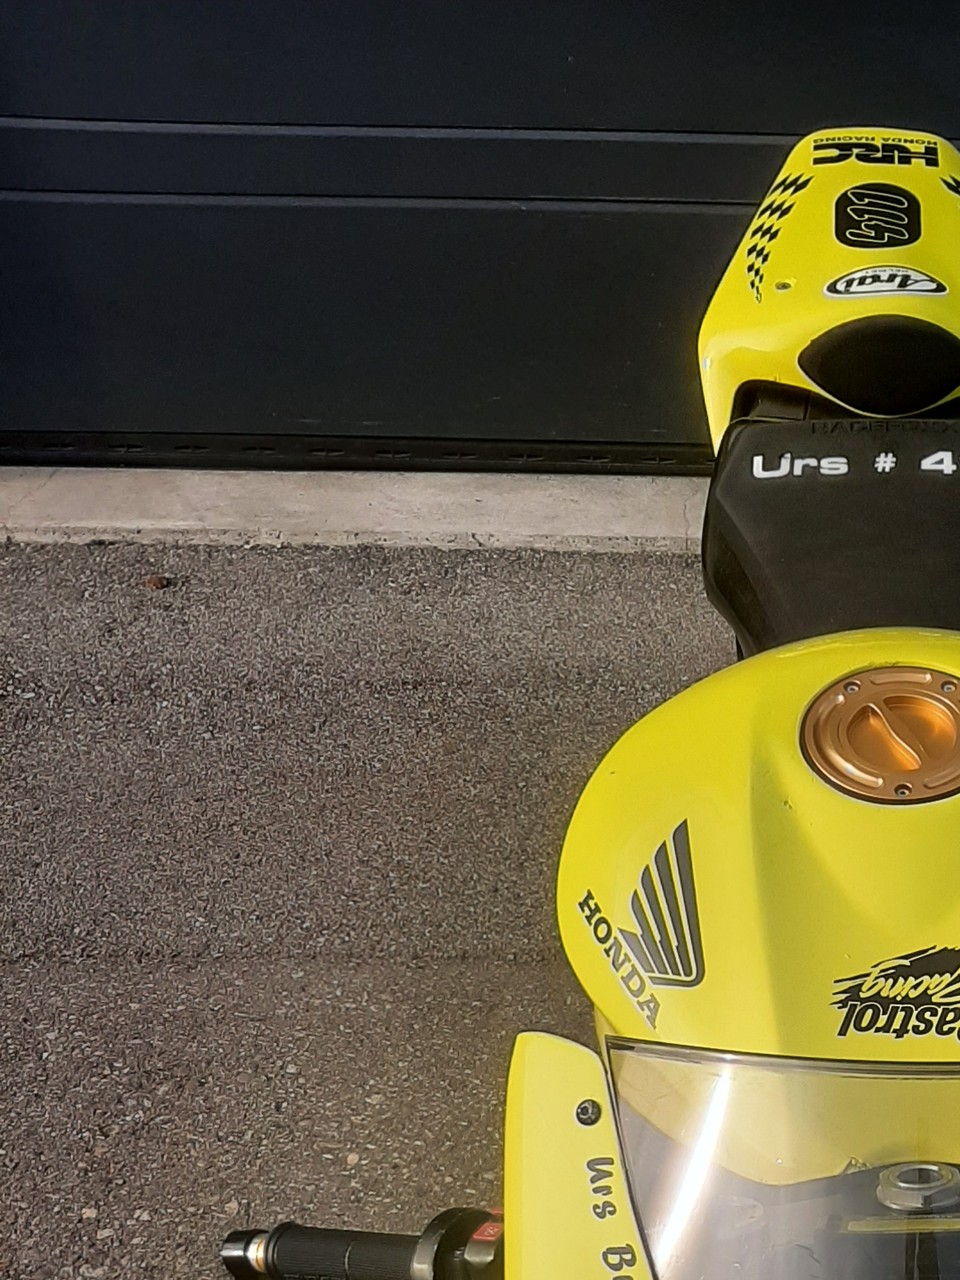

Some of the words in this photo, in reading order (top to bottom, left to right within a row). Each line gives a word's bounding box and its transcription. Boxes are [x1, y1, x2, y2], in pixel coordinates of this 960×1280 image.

[813, 135, 876, 143] RACING
[813, 143, 939, 168] HRC
[846, 189, 909, 243] 411
[840, 273, 937, 293] Arai
[753, 453, 849, 479] Urs
[874, 452, 897, 473] #
[578, 889, 661, 1029] HONDA
[586, 1157, 615, 1219] Urs
